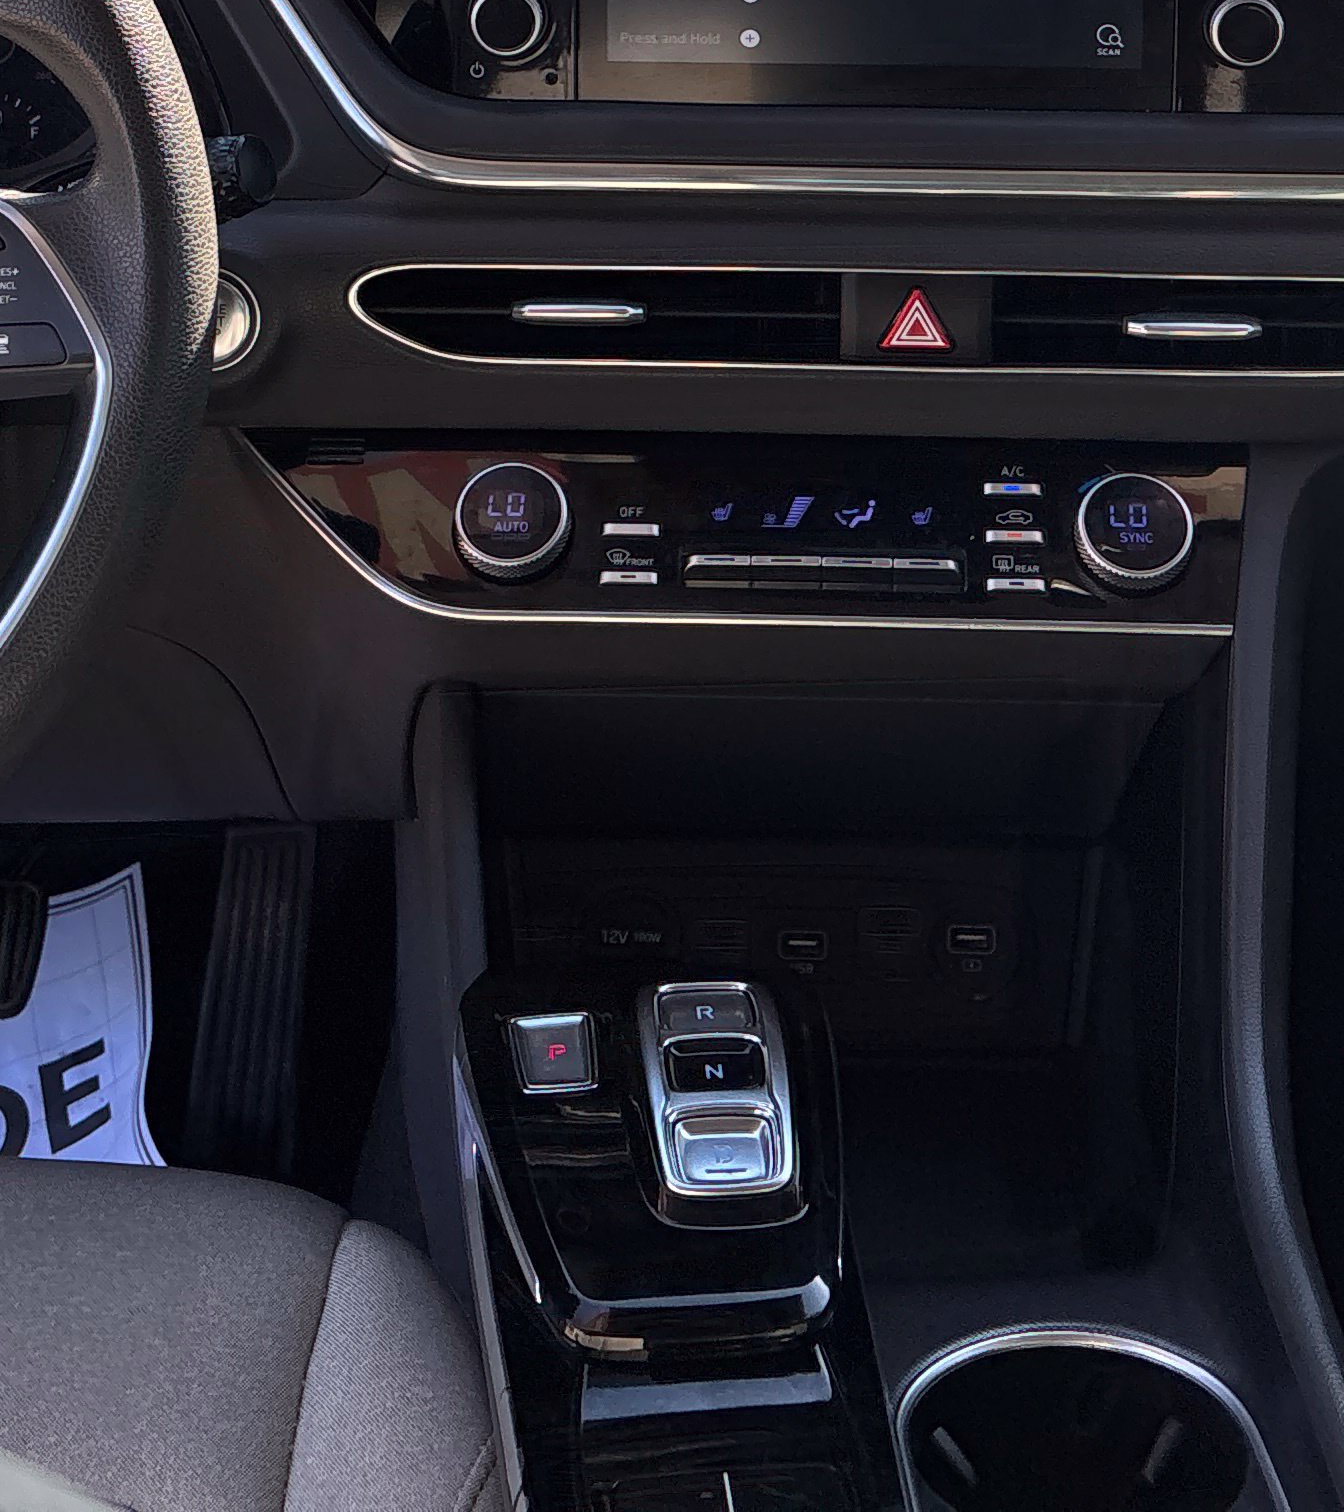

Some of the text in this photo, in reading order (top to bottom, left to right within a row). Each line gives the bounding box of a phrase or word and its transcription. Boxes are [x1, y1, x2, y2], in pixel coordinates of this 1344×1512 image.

[619, 32, 721, 45] Press and Hold
[1096, 48, 1121, 56] SCAN
[30, 126, 40, 139] F
[1000, 465, 1025, 478] A/C
[619, 506, 645, 518] OFF
[494, 520, 529, 533] AUTO
[1119, 532, 1154, 544] SYNC
[625, 557, 654, 566] FRONT
[1014, 564, 1040, 574] REAR
[696, 1004, 715, 1021] R
[548, 1043, 566, 1060] P
[704, 1063, 724, 1080] N
